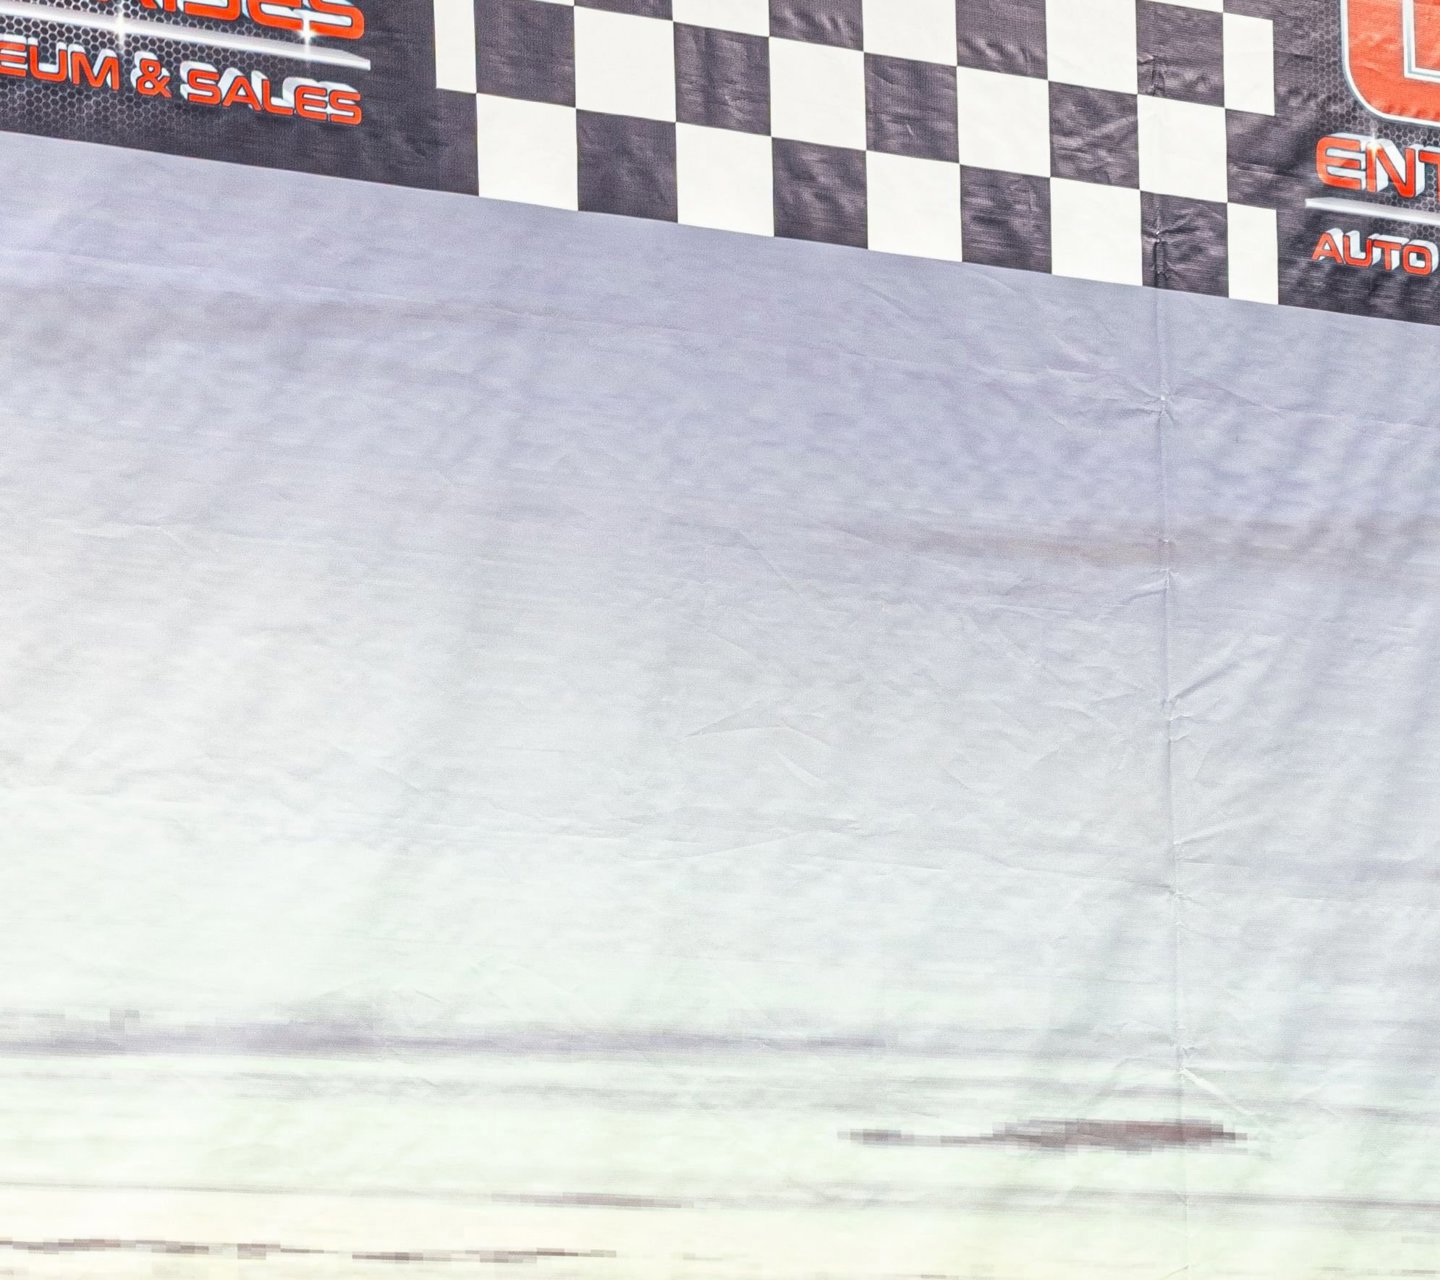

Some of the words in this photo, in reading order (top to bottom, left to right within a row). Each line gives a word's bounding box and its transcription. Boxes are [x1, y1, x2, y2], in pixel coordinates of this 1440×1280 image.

[130, 50, 173, 98] &
[180, 60, 363, 126] SALES
[1311, 228, 1435, 276] AUTO
